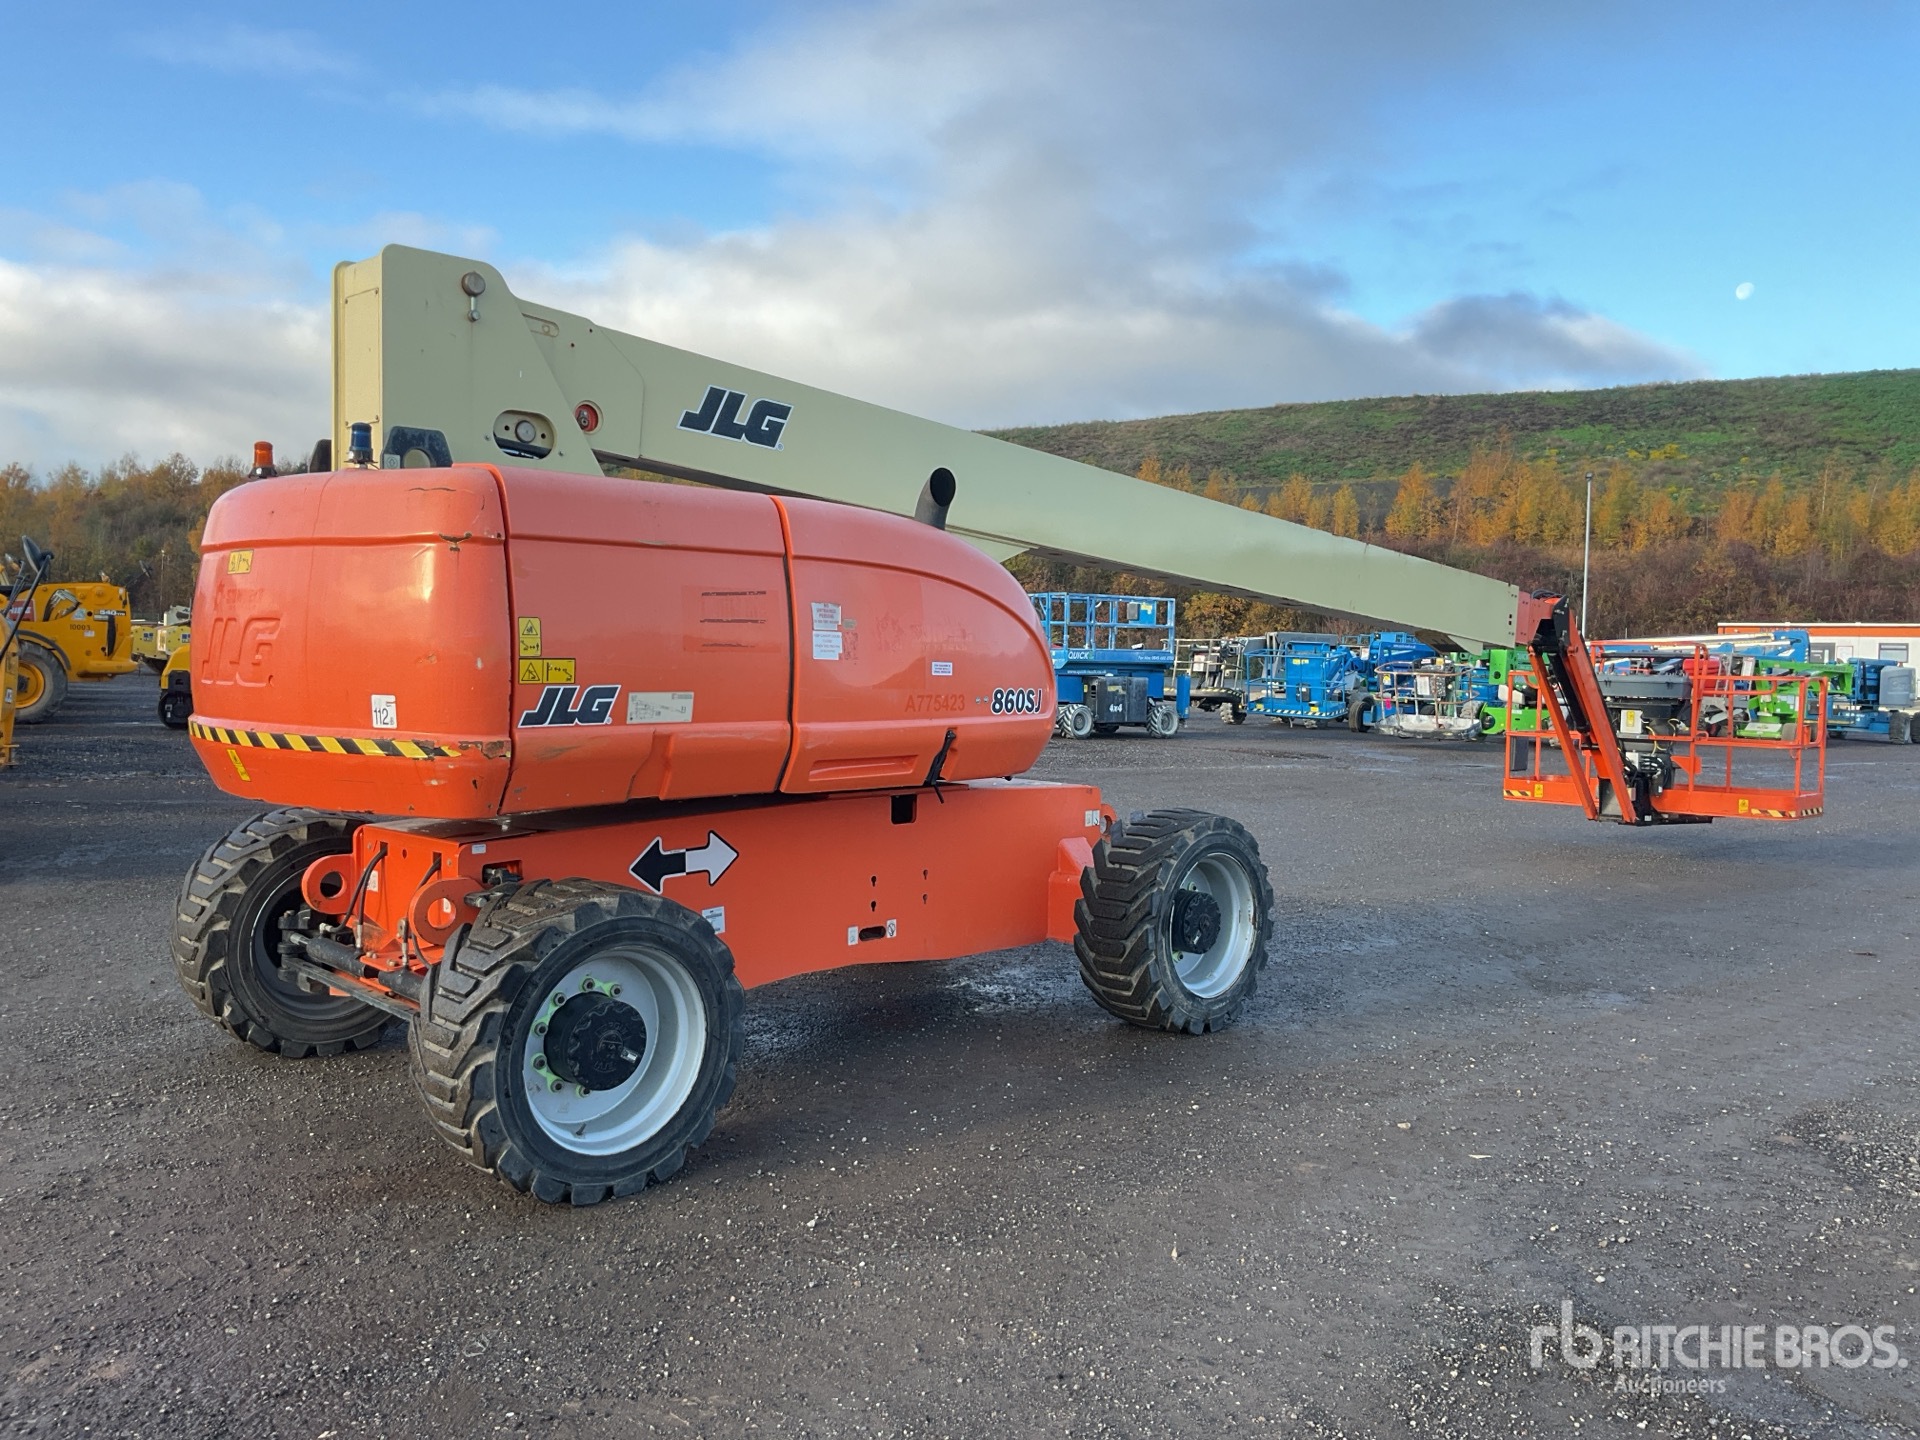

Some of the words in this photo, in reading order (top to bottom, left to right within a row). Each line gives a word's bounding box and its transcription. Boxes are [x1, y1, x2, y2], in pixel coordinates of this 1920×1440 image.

[677, 384, 794, 450] JLG
[1068, 651, 1089, 660] QUICK
[517, 684, 621, 728] JLG
[904, 694, 966, 713] A775423
[991, 687, 1043, 715] 860SJ
[1109, 703, 1123, 713] 4x4
[373, 707, 390, 726] 112
